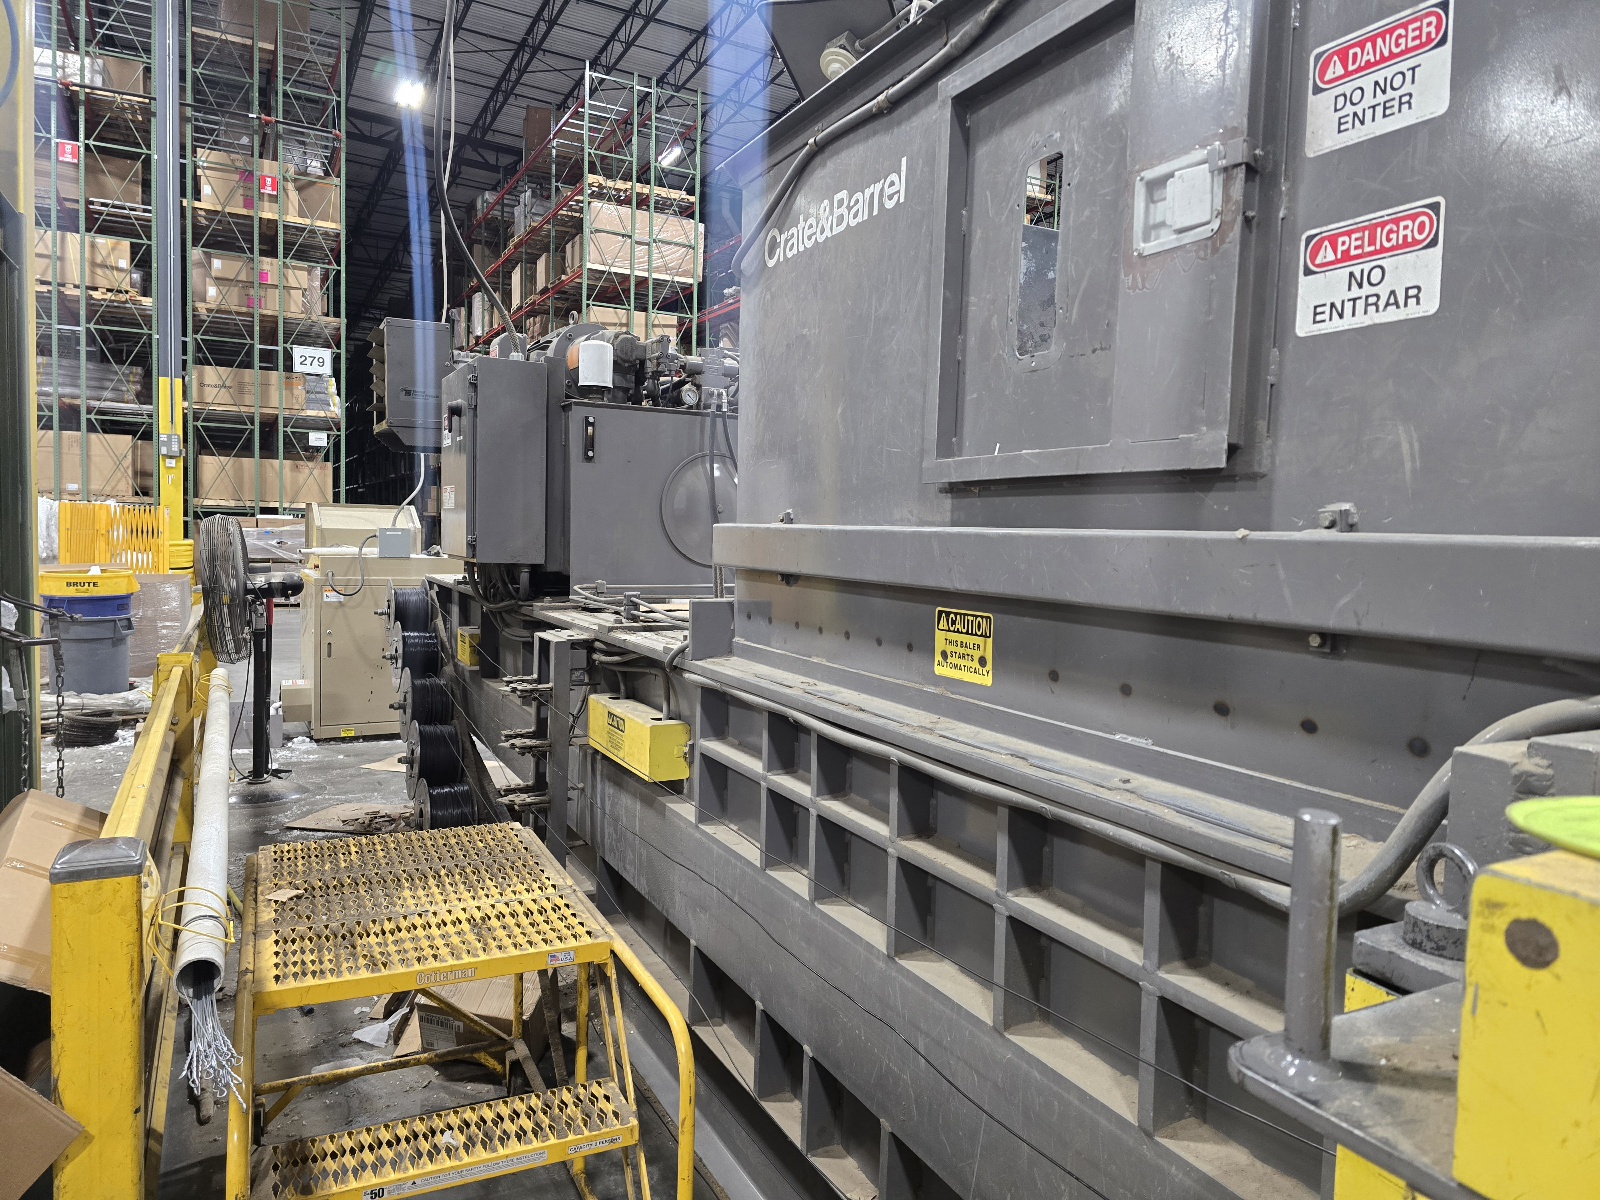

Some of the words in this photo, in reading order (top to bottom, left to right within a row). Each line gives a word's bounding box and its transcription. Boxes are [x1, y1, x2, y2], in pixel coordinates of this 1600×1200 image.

[1347, 15, 1438, 72] DANGER
[1333, 86, 1366, 114] DO
[1372, 64, 1422, 99] NOT
[1337, 92, 1414, 135] ENTER
[764, 156, 907, 267] Crate&Barrel
[1337, 215, 1430, 260] PELIGRO
[1347, 264, 1387, 292] NO
[1312, 285, 1423, 325] ENTRAR
[299, 354, 326, 368] 279
[948, 613, 990, 637] CAUTION
[944, 638, 959, 647] THIS
[960, 640, 981, 651] BALER
[949, 650, 975, 662] STARTS
[936, 659, 991, 677] AUTOMATICALLY
[416, 967, 477, 985] Cotterman
[370, 1187, 385, 1200] 50
